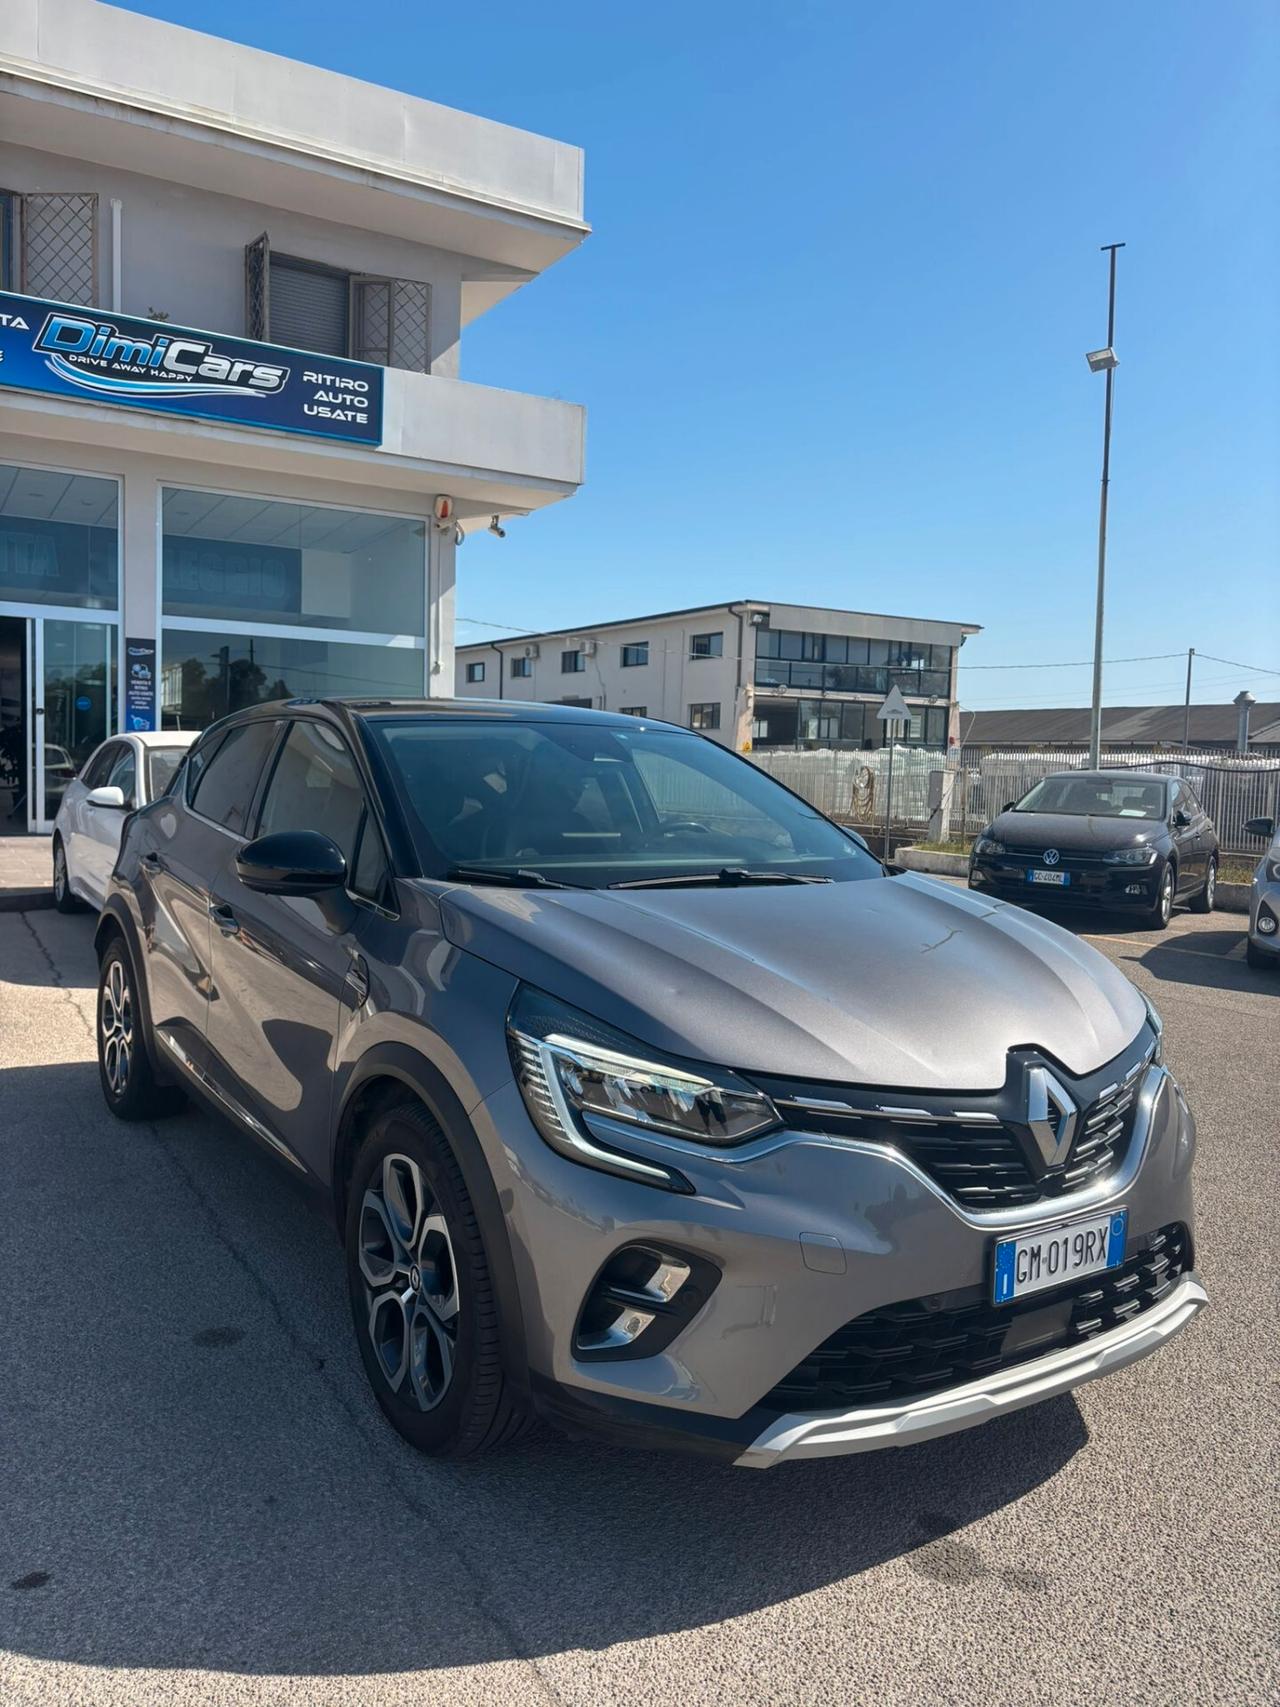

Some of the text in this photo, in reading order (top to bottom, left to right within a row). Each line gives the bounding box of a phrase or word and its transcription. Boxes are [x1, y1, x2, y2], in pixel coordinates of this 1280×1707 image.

[38, 315, 288, 390] DimiCars
[68, 354, 193, 382] DRIVE AWAY HAPPY
[303, 371, 369, 392] RITIRO
[313, 390, 369, 408] AUTO
[303, 403, 369, 424] USATE
